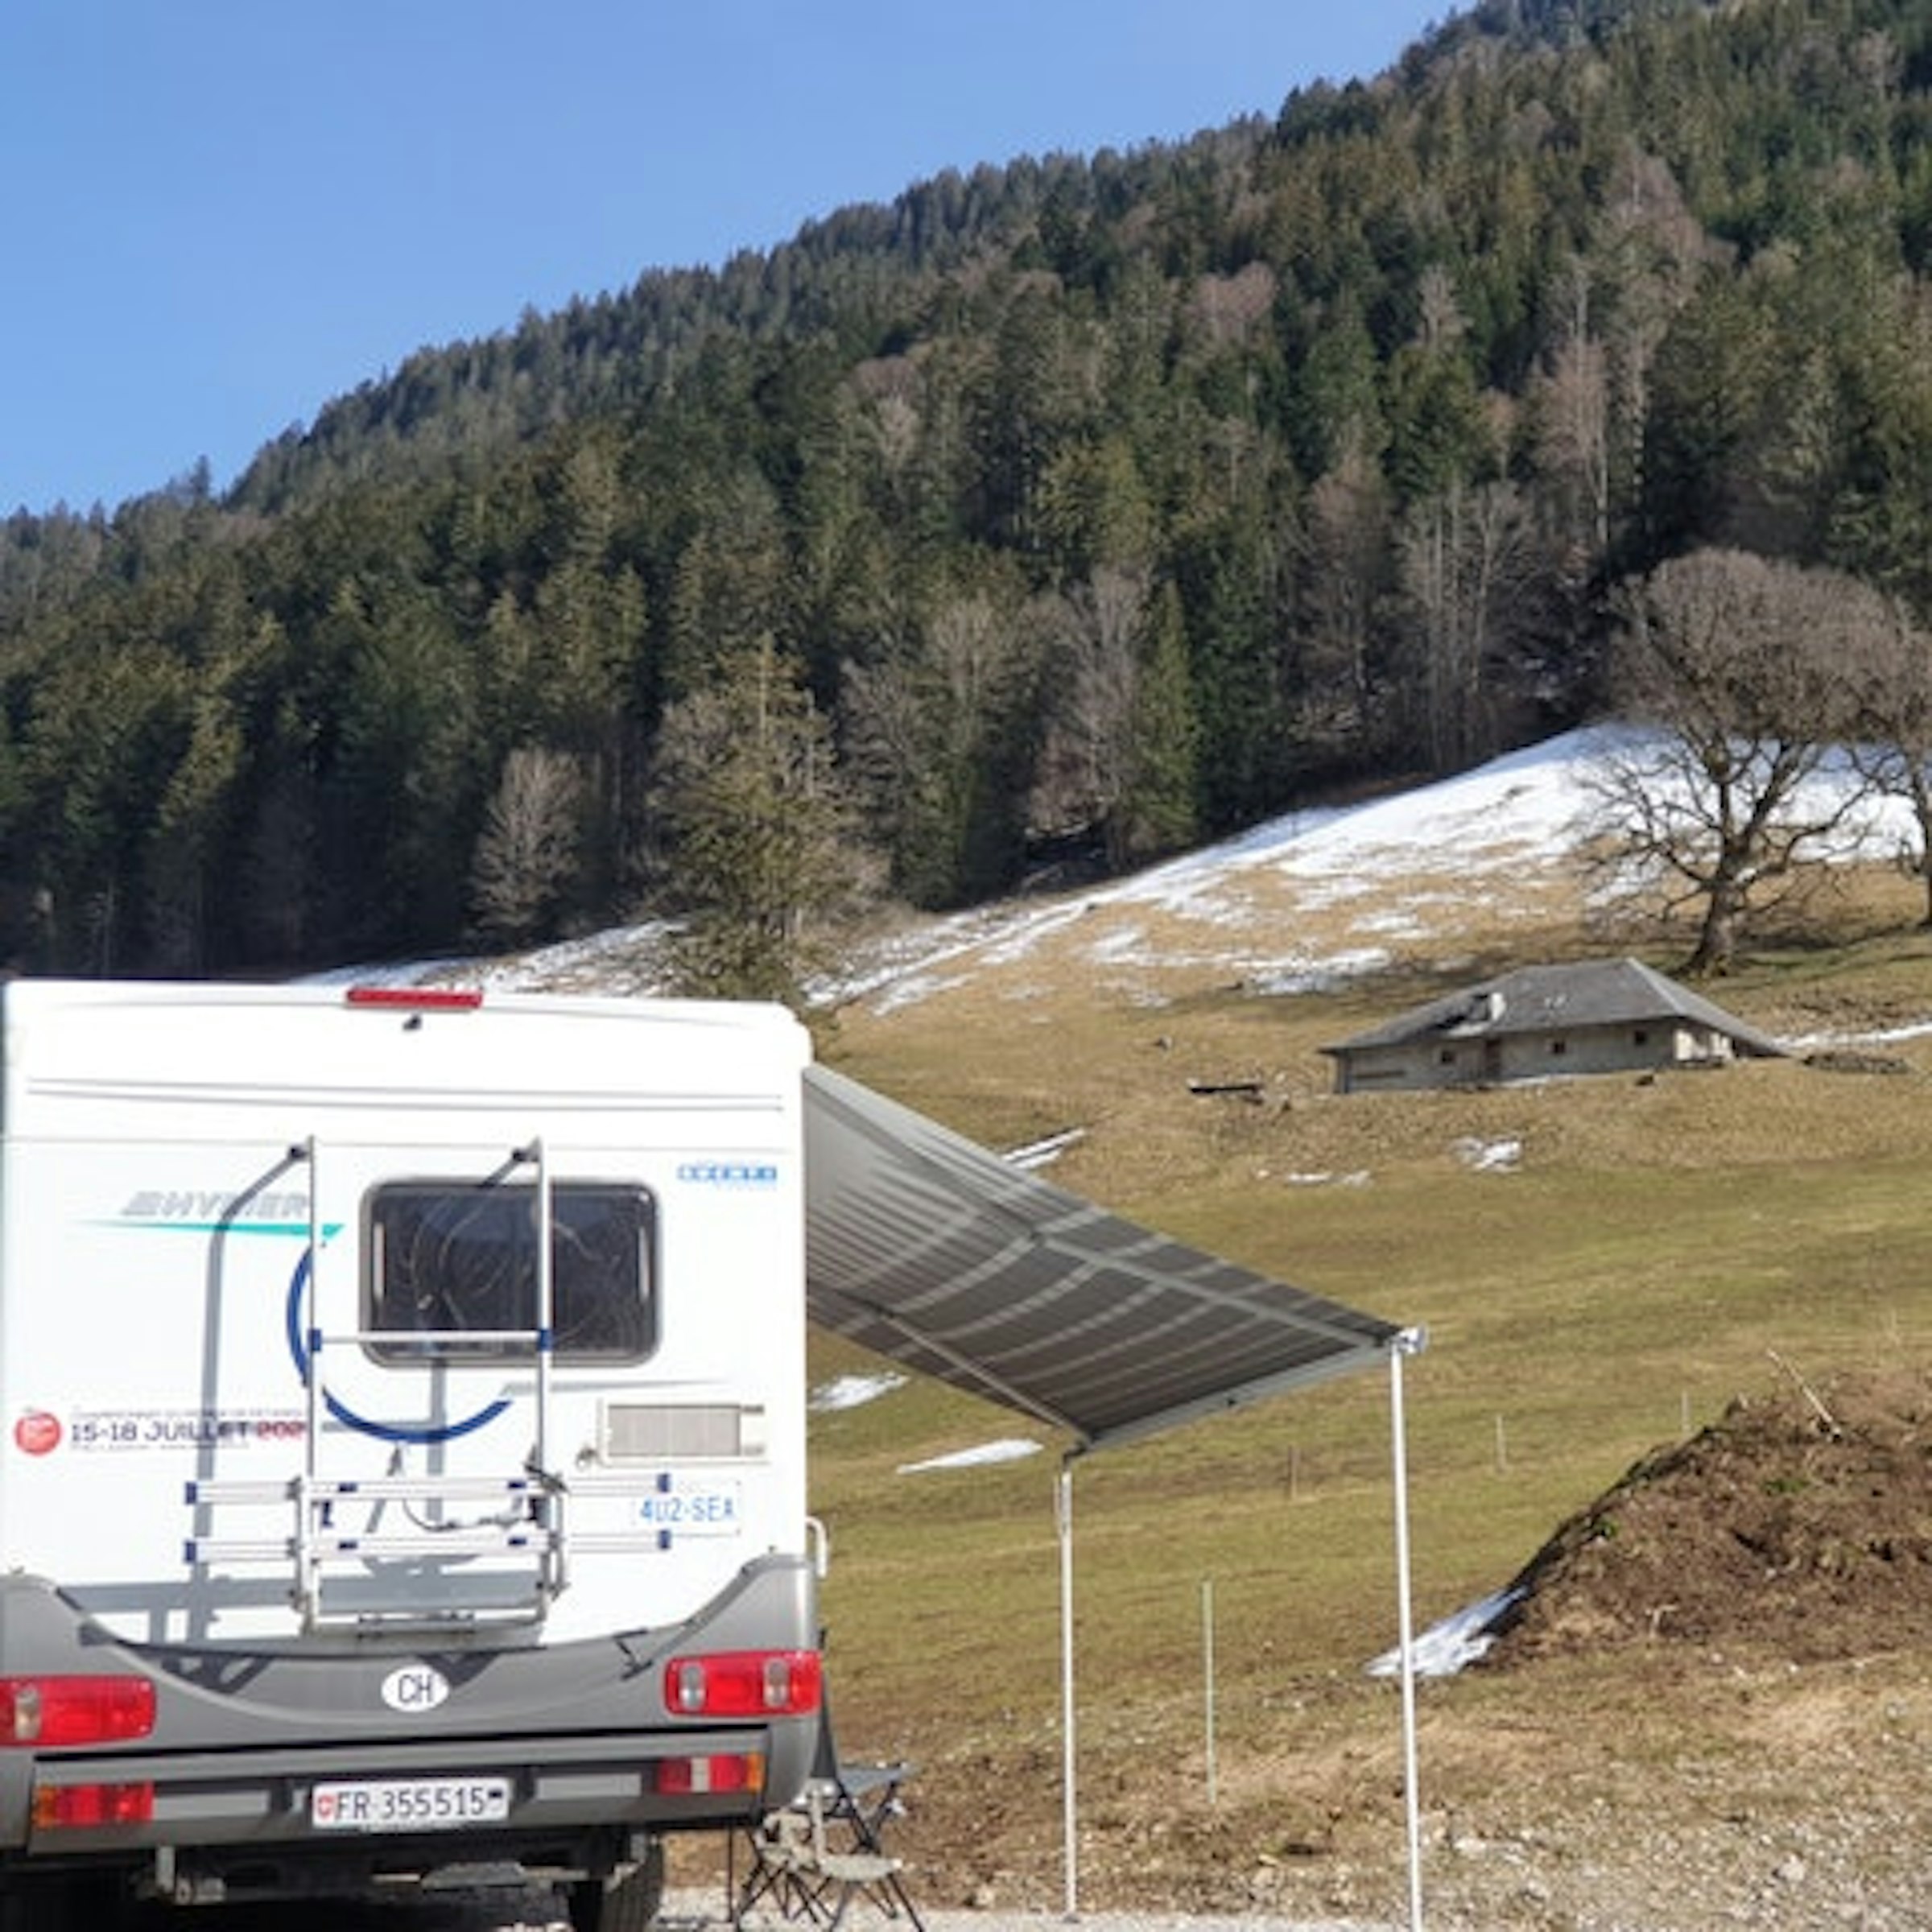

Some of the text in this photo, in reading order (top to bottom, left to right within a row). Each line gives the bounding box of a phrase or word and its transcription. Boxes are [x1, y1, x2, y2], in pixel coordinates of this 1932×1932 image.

[71, 1422, 138, 1442] 15-18
[143, 1421, 248, 1442] JUILLET
[255, 1422, 309, 1440] 202
[398, 1674, 434, 1703] CH
[382, 1786, 485, 1819] 355515
